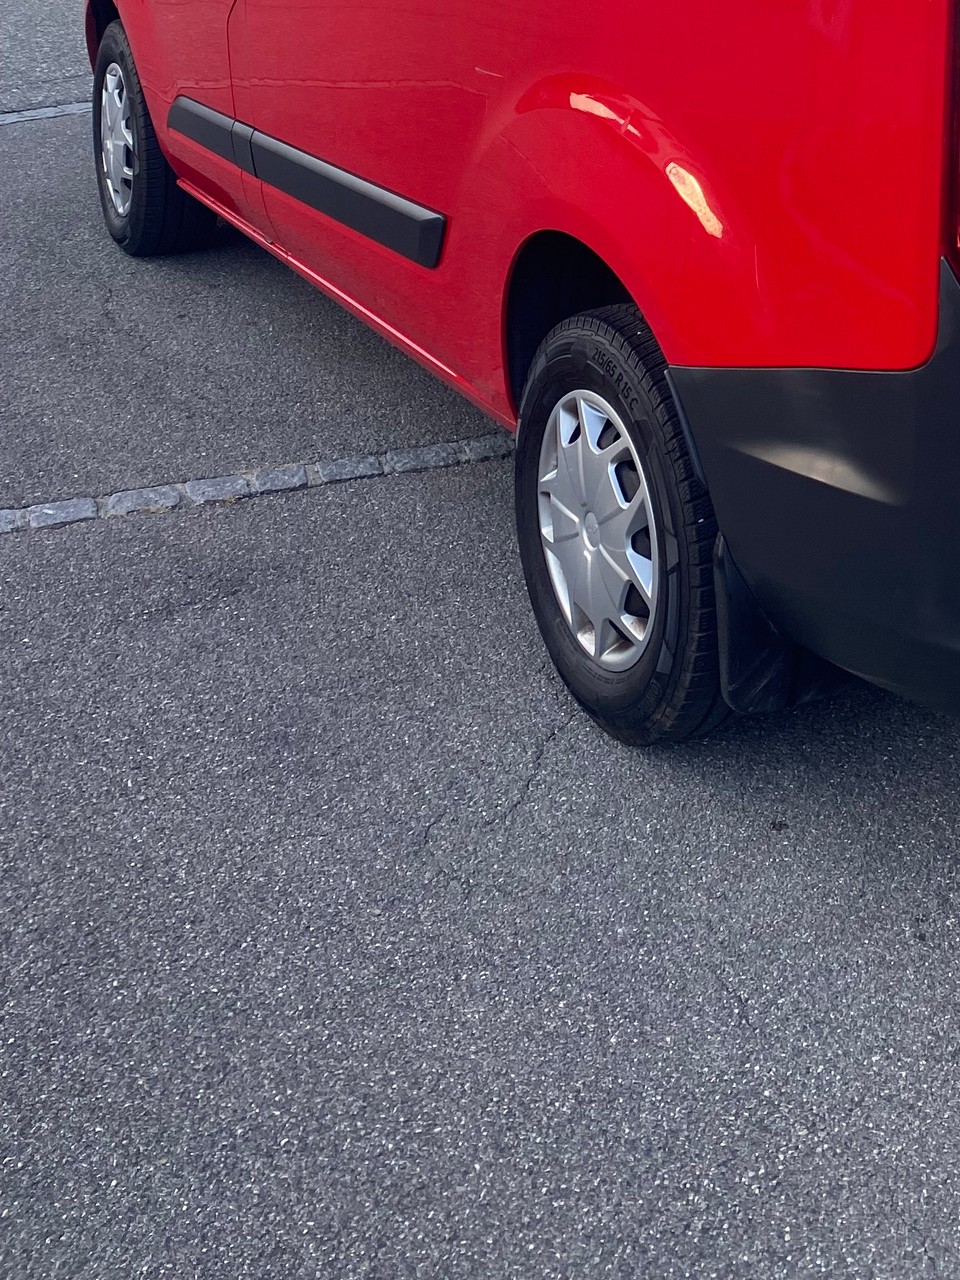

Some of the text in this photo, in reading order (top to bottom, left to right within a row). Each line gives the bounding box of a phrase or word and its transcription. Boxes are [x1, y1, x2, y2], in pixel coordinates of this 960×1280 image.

[592, 347, 639, 411] 215/65 R 15 C
